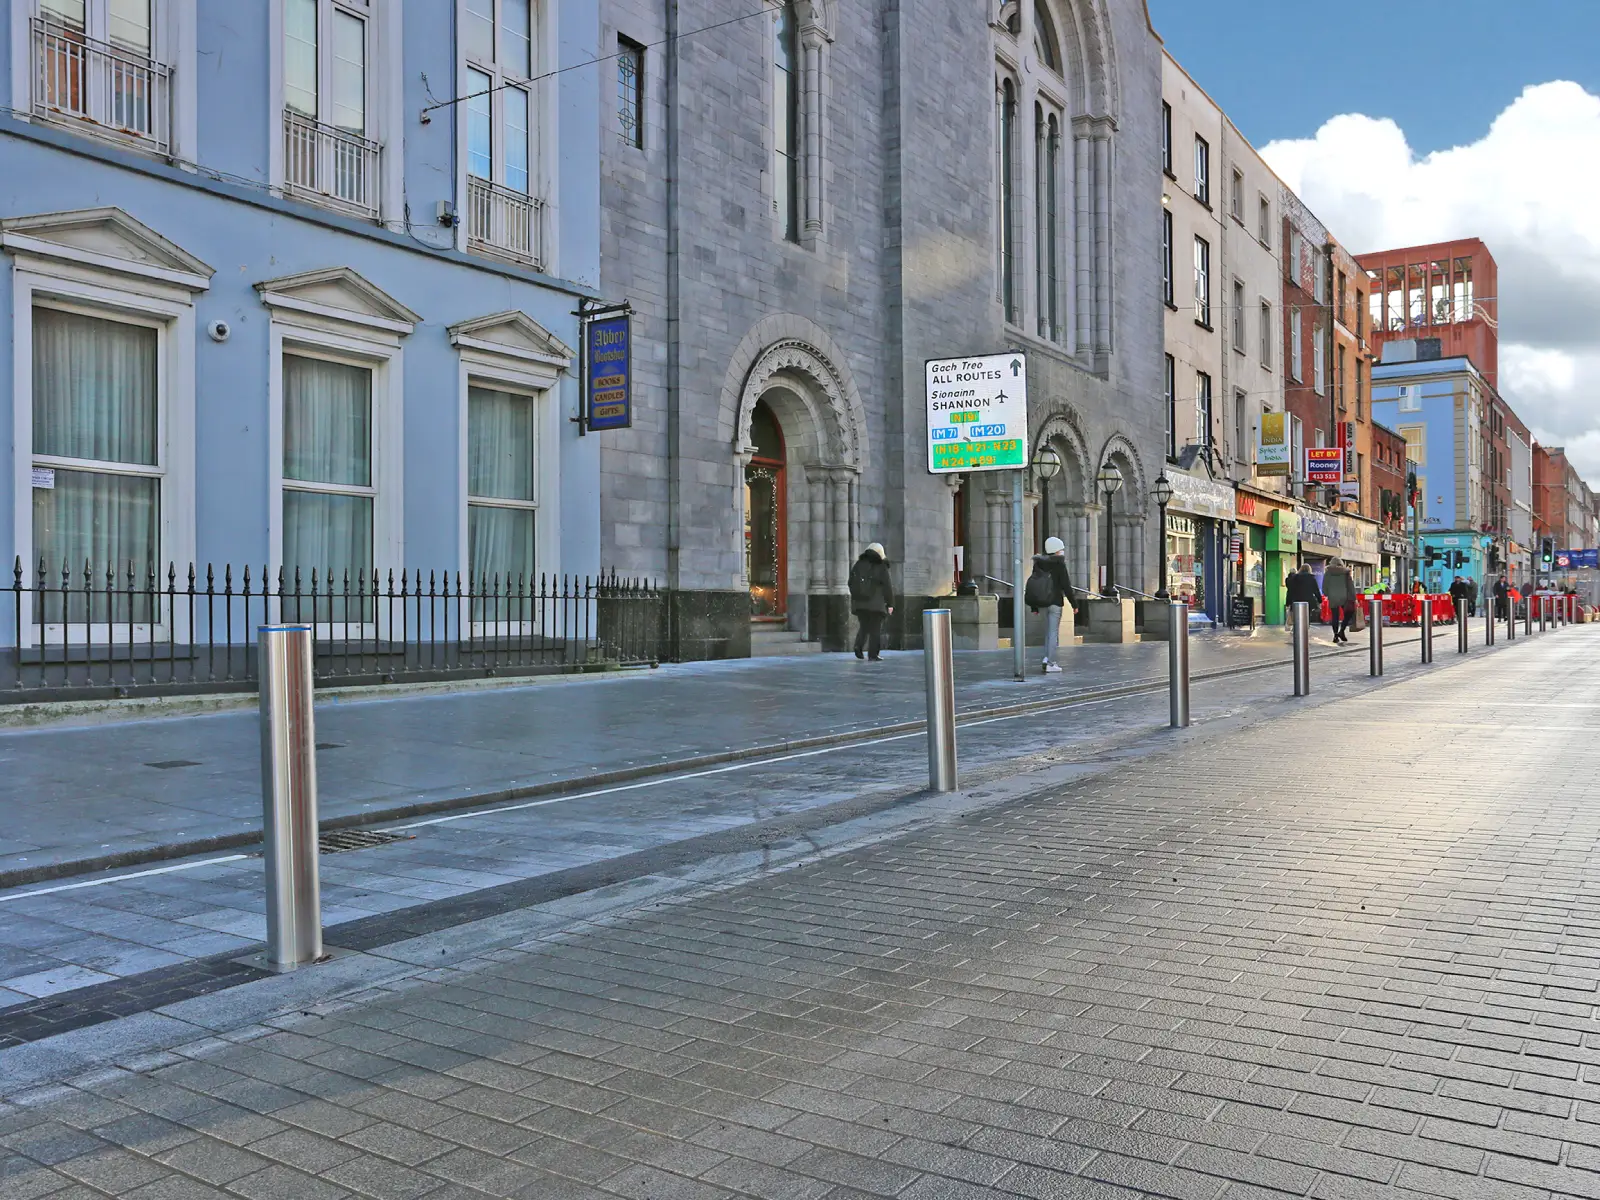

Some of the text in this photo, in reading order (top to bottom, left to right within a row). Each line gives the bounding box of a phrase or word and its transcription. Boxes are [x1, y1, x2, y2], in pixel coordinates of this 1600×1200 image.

[594, 330, 625, 346] Abbey
[931, 361, 983, 372] Gach Treo
[598, 377, 621, 387] BOOKS
[932, 370, 1001, 384] ALL ROUTES
[595, 392, 624, 402] CANDLES
[931, 389, 975, 399] Sionainn
[932, 398, 990, 410] SHANNON
[1311, 450, 1325, 458] LET
[1310, 462, 1339, 470] Rooney
